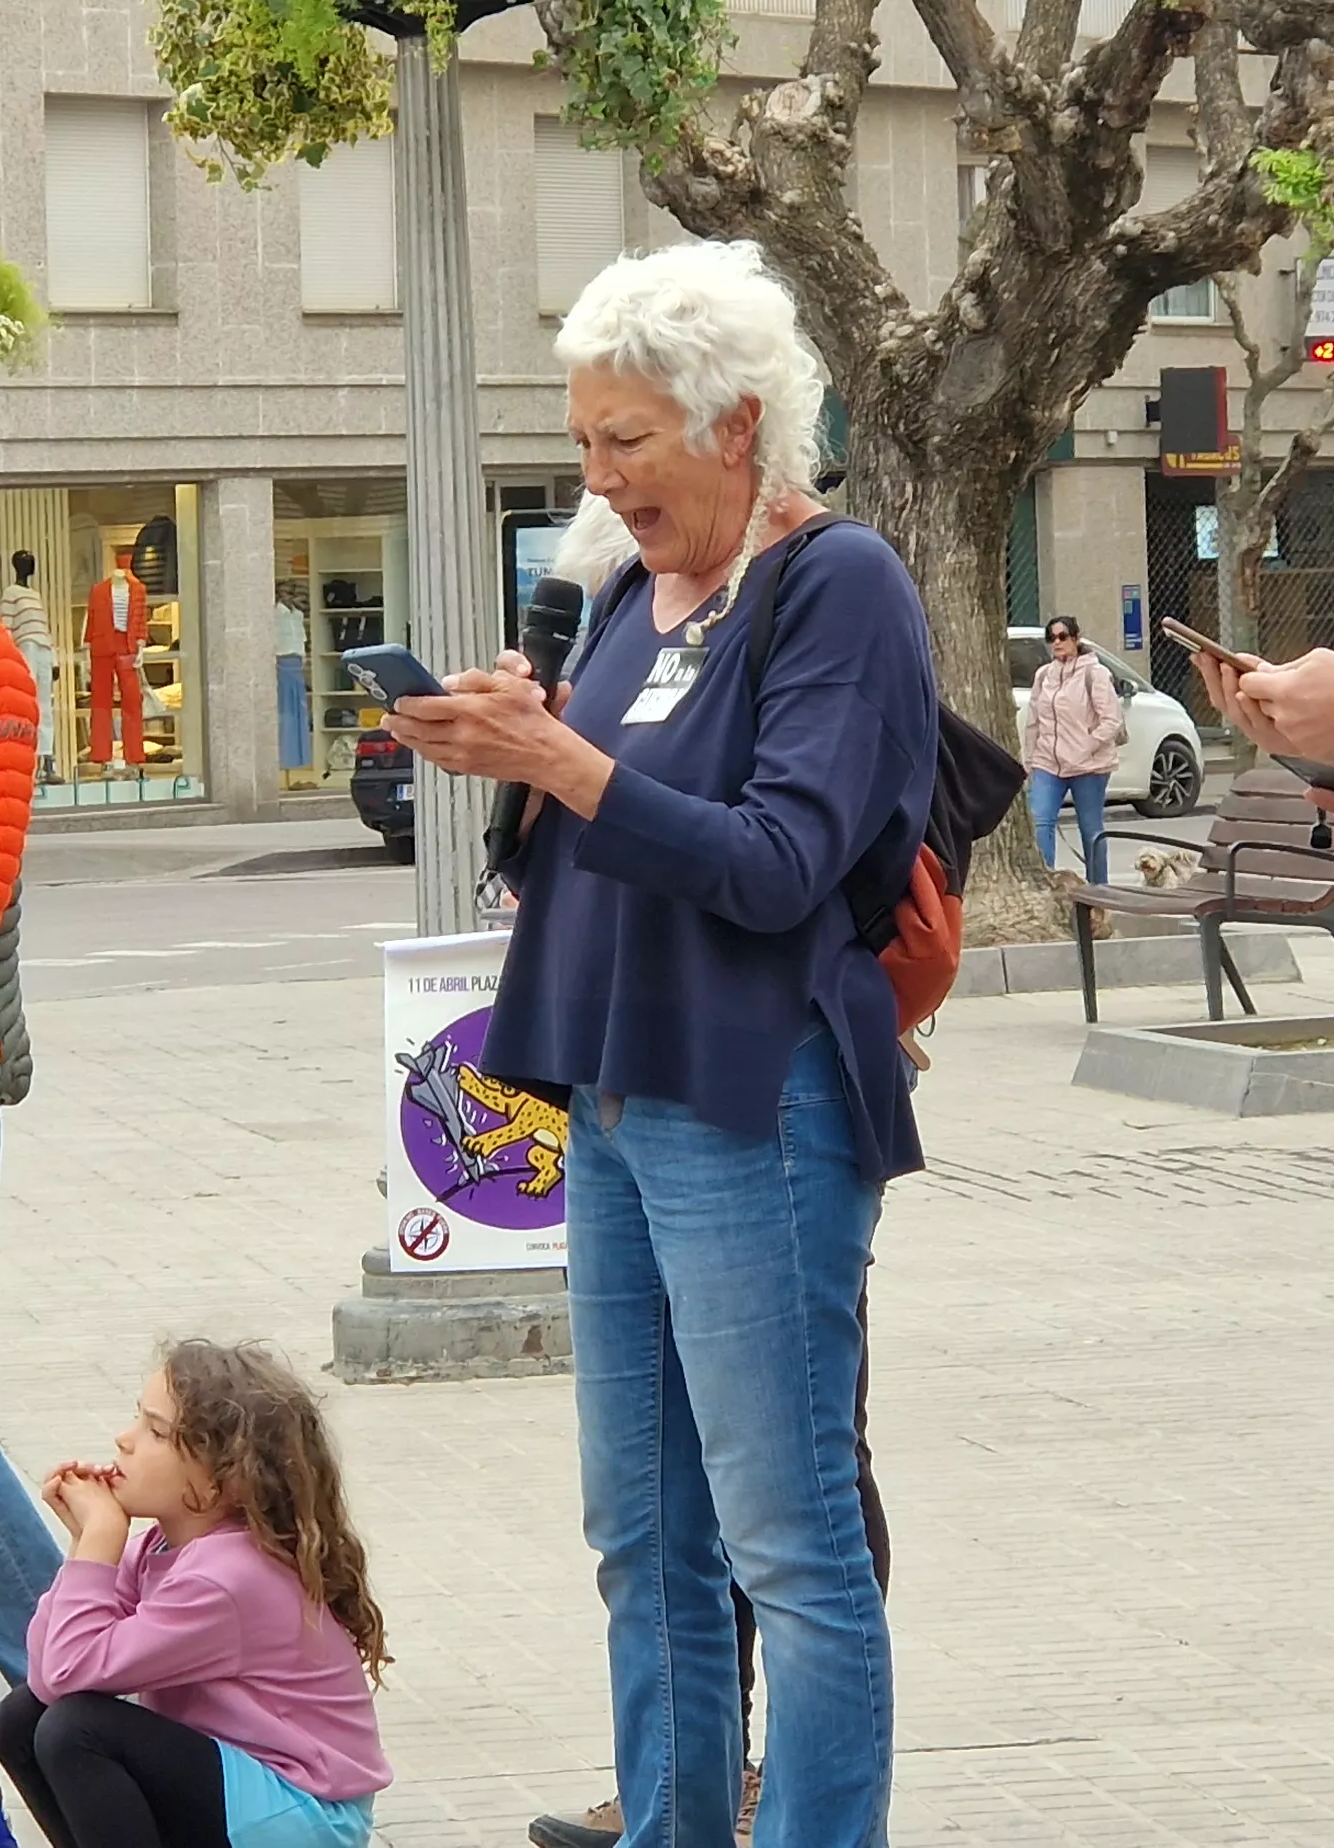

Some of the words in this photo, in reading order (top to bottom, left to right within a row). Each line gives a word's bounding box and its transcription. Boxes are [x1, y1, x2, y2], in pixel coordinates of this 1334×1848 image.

[646, 652, 681, 684] NO
[408, 977, 421, 993] 11
[423, 977, 438, 992] DE
[439, 976, 470, 992] ABRIL
[471, 975, 499, 991] PLAZ
